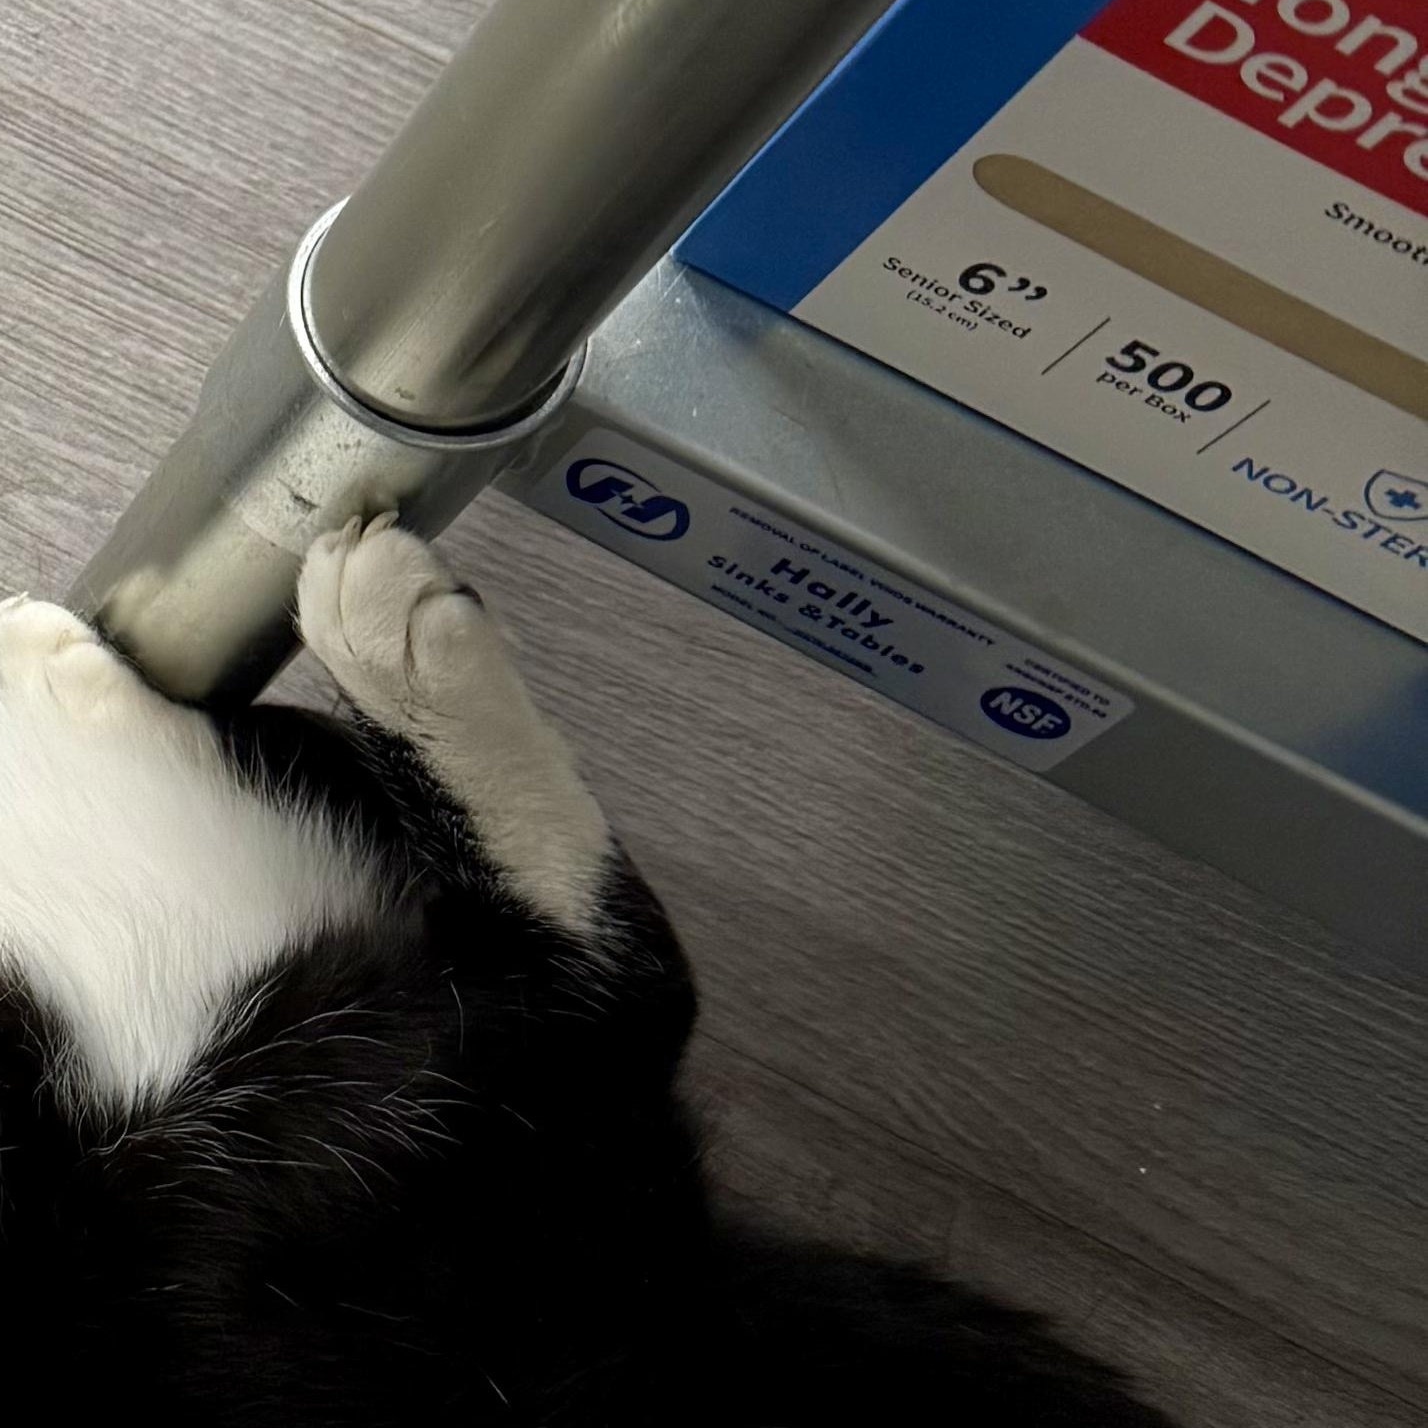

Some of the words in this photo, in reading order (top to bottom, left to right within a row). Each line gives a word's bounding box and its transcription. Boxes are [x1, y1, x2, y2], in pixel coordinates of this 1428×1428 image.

[883, 256, 964, 302] Senior
[964, 298, 1032, 340] Sized
[906, 289, 947, 315] (15.2
[948, 310, 979, 332] cm)
[1096, 371, 1143, 397] per
[1144, 394, 1192, 424] Box
[1105, 339, 1232, 412] 500
[729, 507, 795, 545] REMOVAL
[707, 555, 790, 604] Sinks
[770, 557, 893, 628] Hally
[989, 690, 1063, 733] NSF
